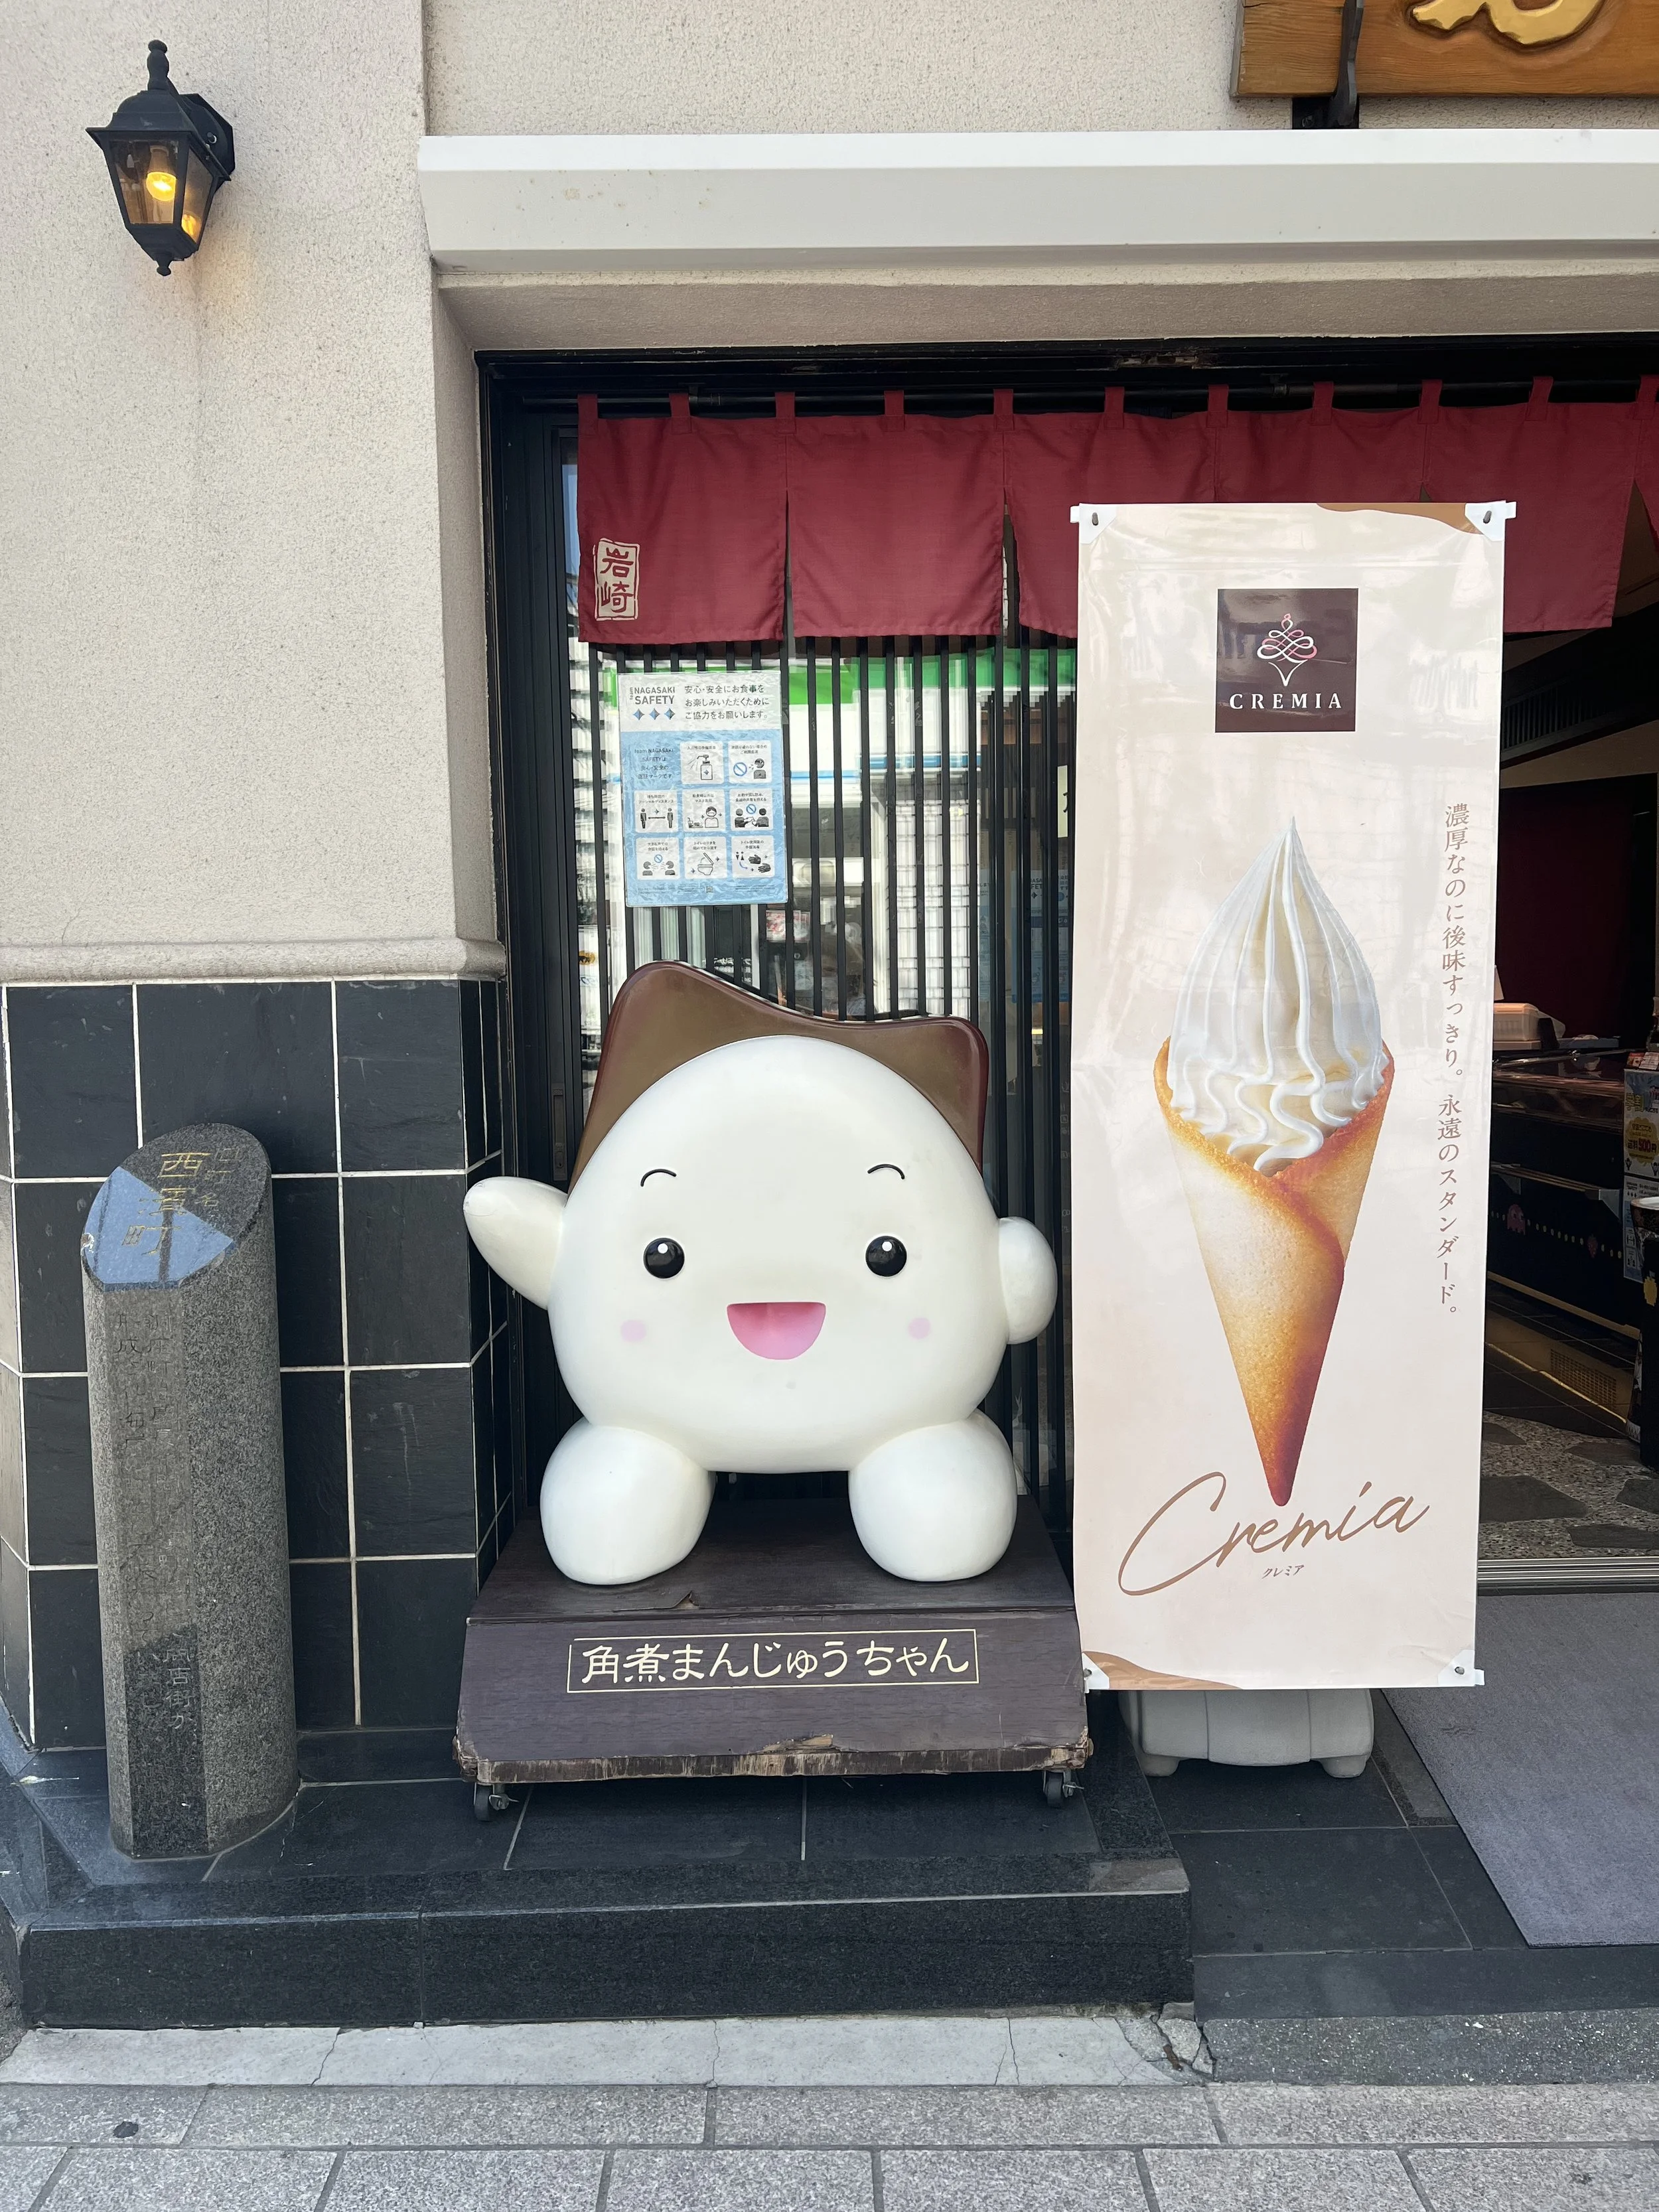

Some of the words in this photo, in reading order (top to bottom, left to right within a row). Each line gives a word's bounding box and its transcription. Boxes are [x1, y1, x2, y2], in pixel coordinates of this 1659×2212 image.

[600, 547, 634, 613] 岩崎
[684, 684, 764, 694] 安心・安全にお食事を
[634, 696, 675, 705] SAFETY
[685, 698, 770, 707] お楽しみいただくために
[1229, 693, 1342, 709] CREMIA
[685, 710, 768, 720] ご協力をお願いします。
[1437, 802, 1470, 1313] 濃厚なのに後味すっきり。永遠のスタンダード。
[1118, 1471, 1430, 1596] Cremia
[1261, 1564, 1305, 1580] クレミア
[582, 1637, 970, 1684] 角煮まんじゅうちゃん
